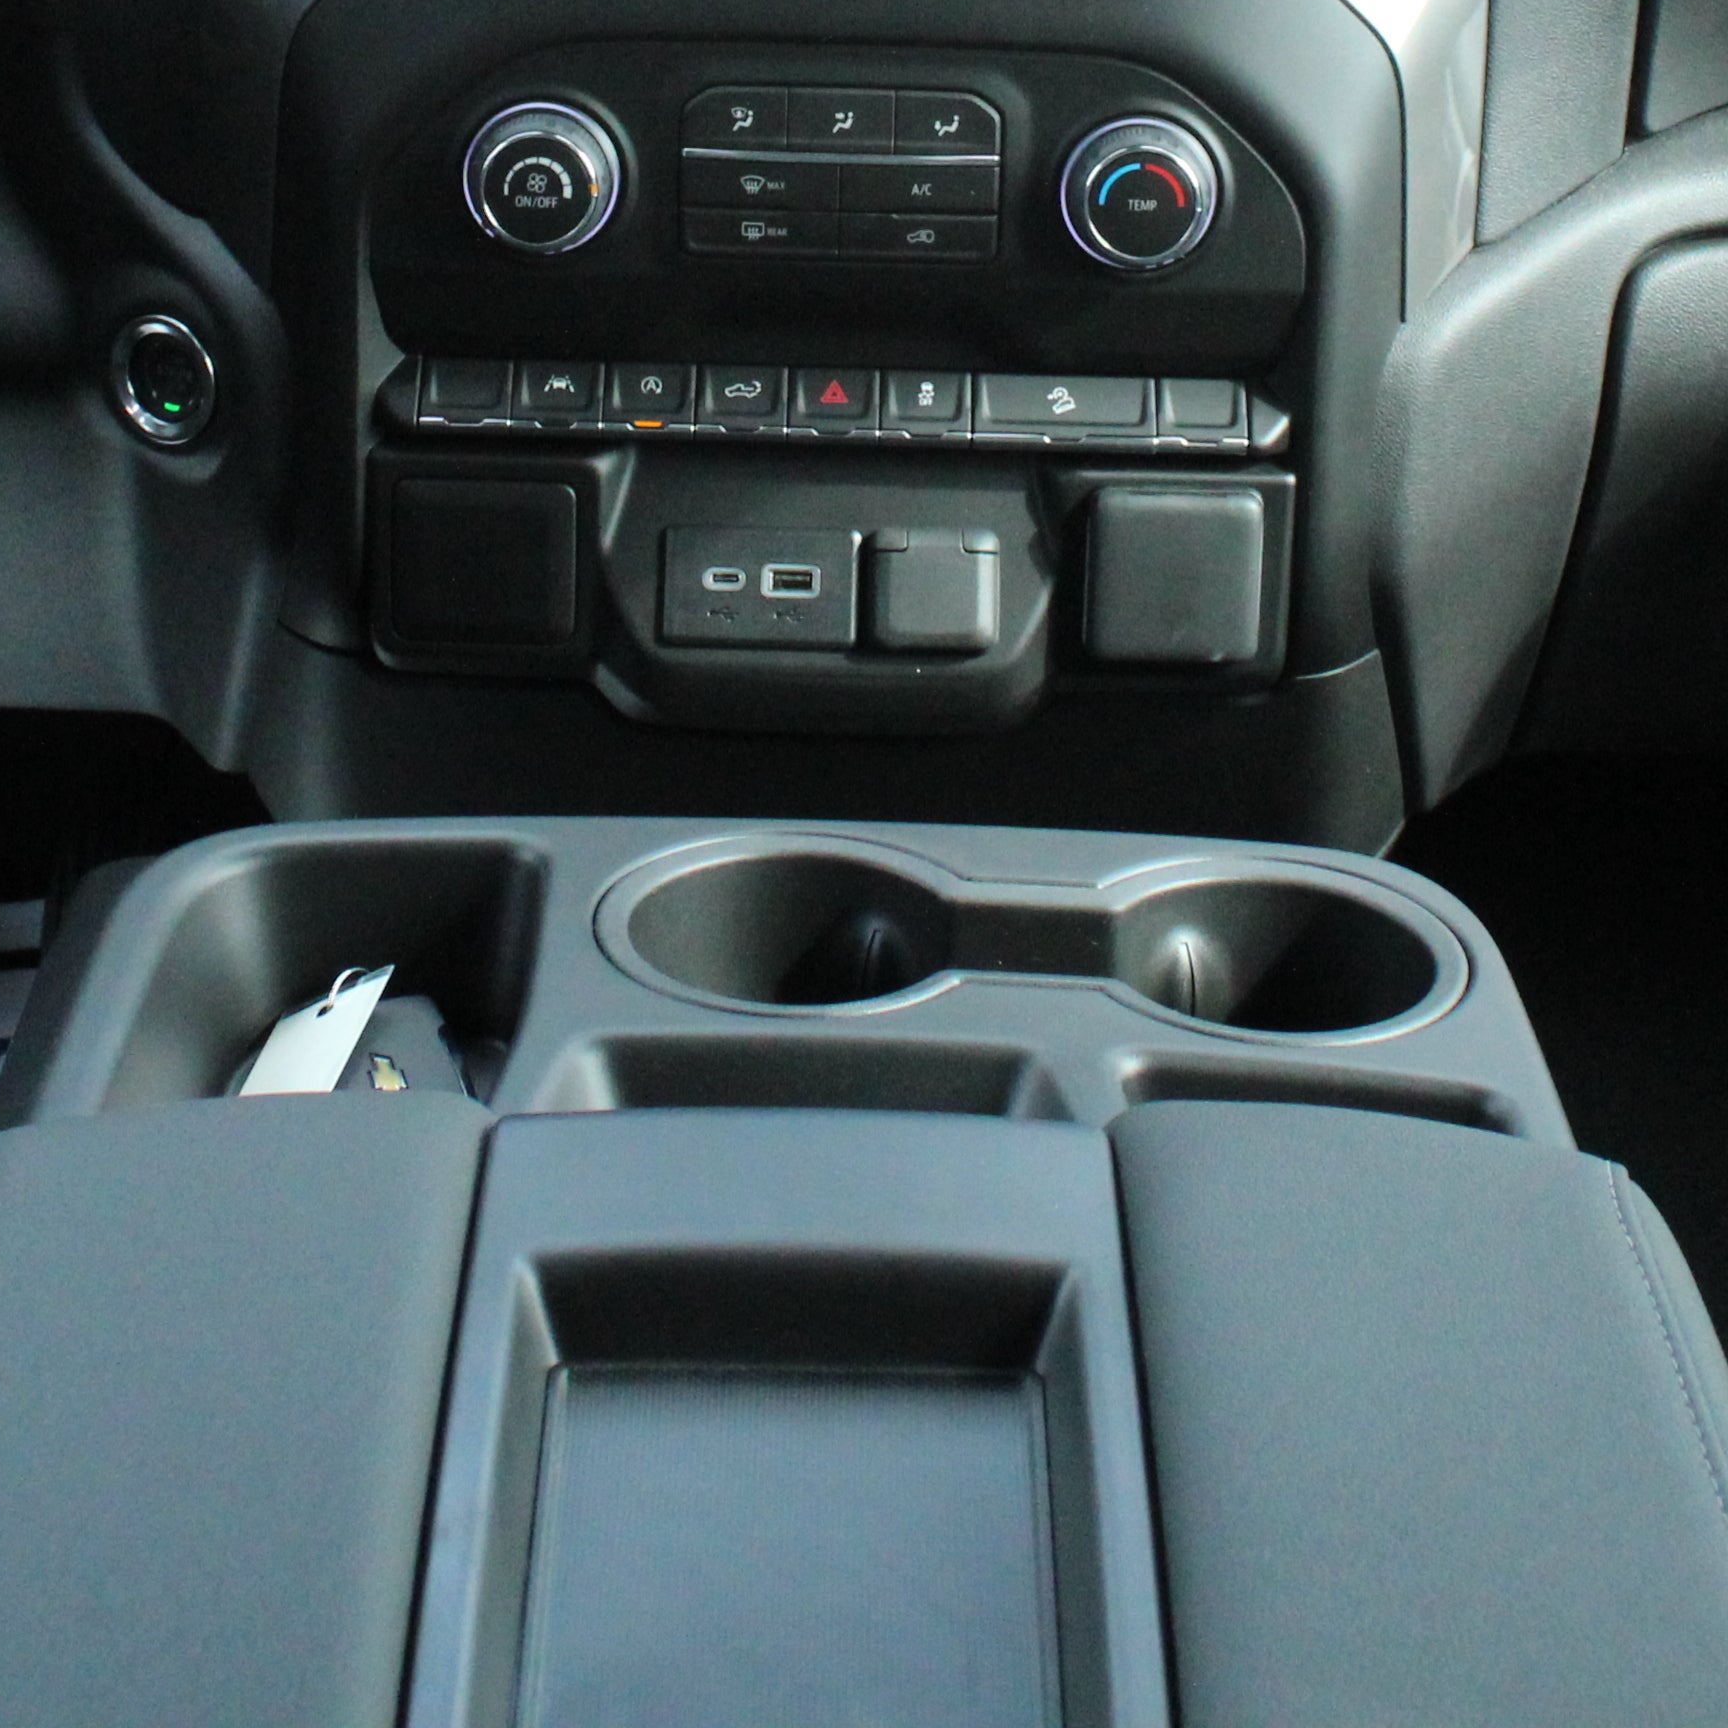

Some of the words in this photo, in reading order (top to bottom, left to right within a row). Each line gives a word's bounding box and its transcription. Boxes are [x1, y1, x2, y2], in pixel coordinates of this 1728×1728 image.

[766, 181, 786, 191] MAX
[911, 182, 933, 197] A/C
[515, 195, 558, 209] ON/OFF
[1127, 198, 1158, 212] TEMP
[766, 226, 788, 237] REAR
